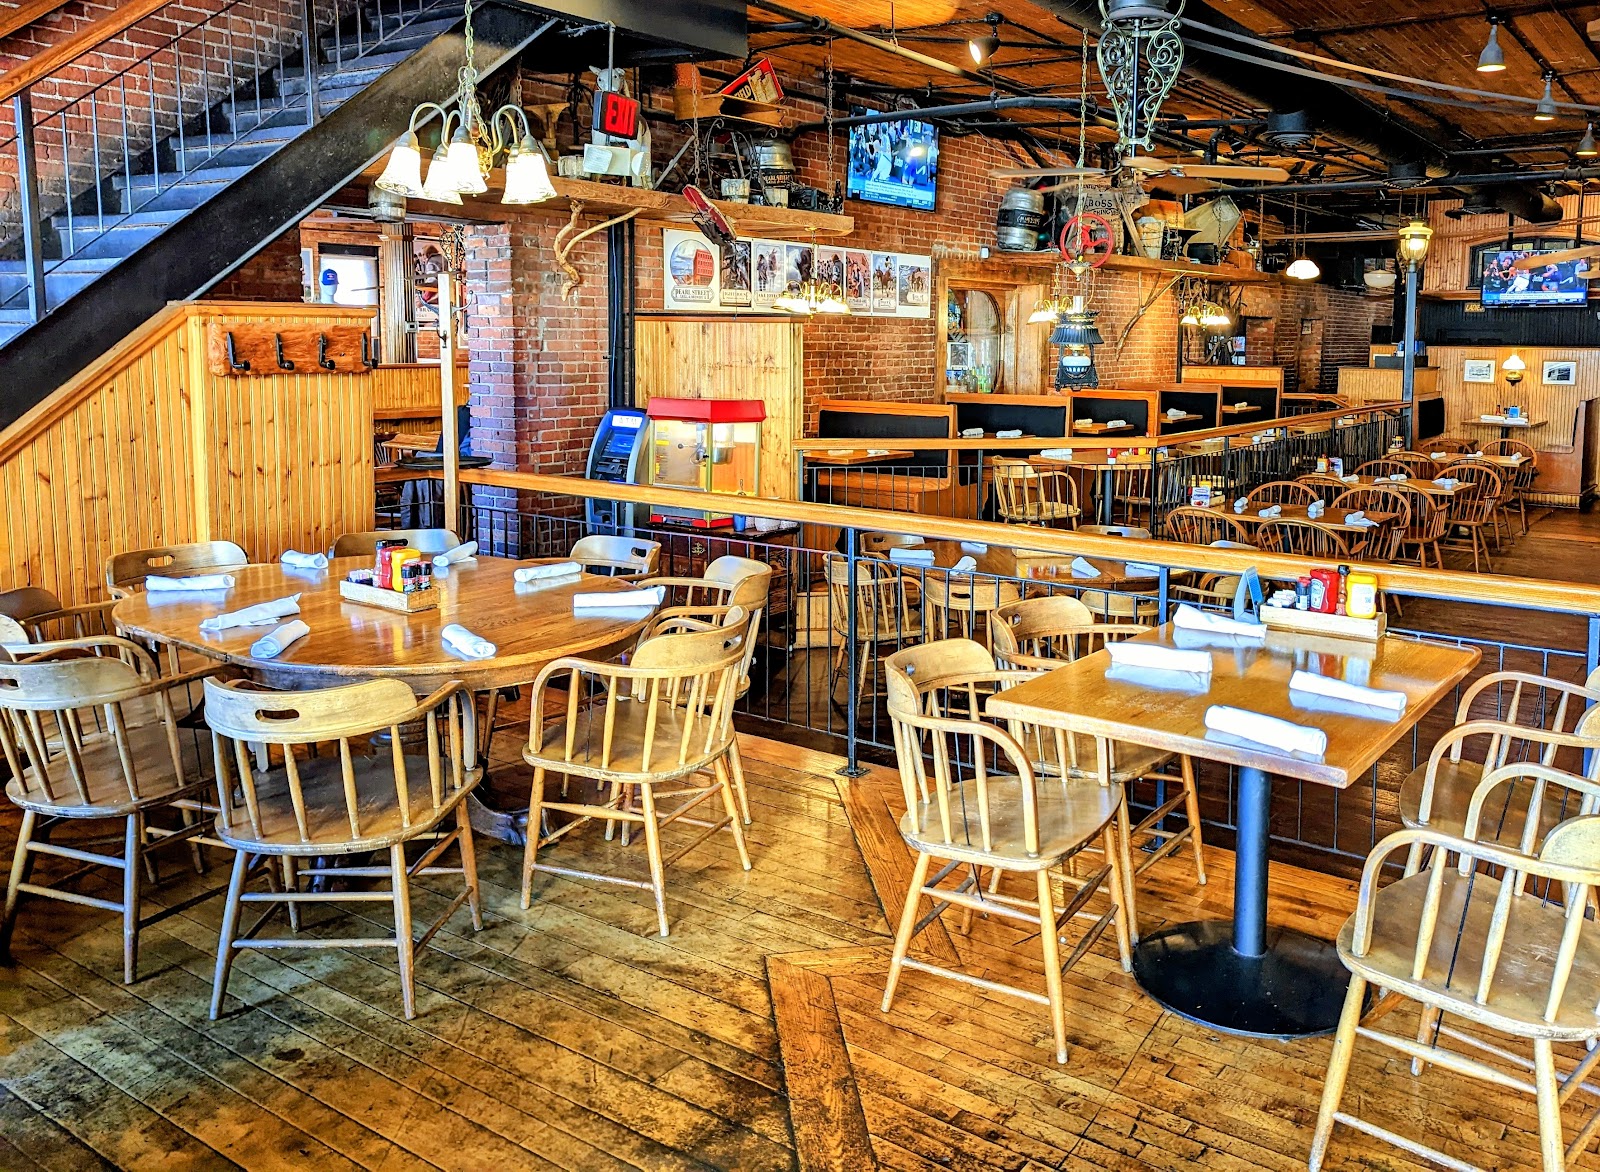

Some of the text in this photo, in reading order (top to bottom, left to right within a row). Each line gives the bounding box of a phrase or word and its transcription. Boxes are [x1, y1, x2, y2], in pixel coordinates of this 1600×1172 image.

[605, 92, 638, 136] EXIT
[1088, 199, 1113, 208] BOSS
[675, 288, 710, 299] PEARL STREET
